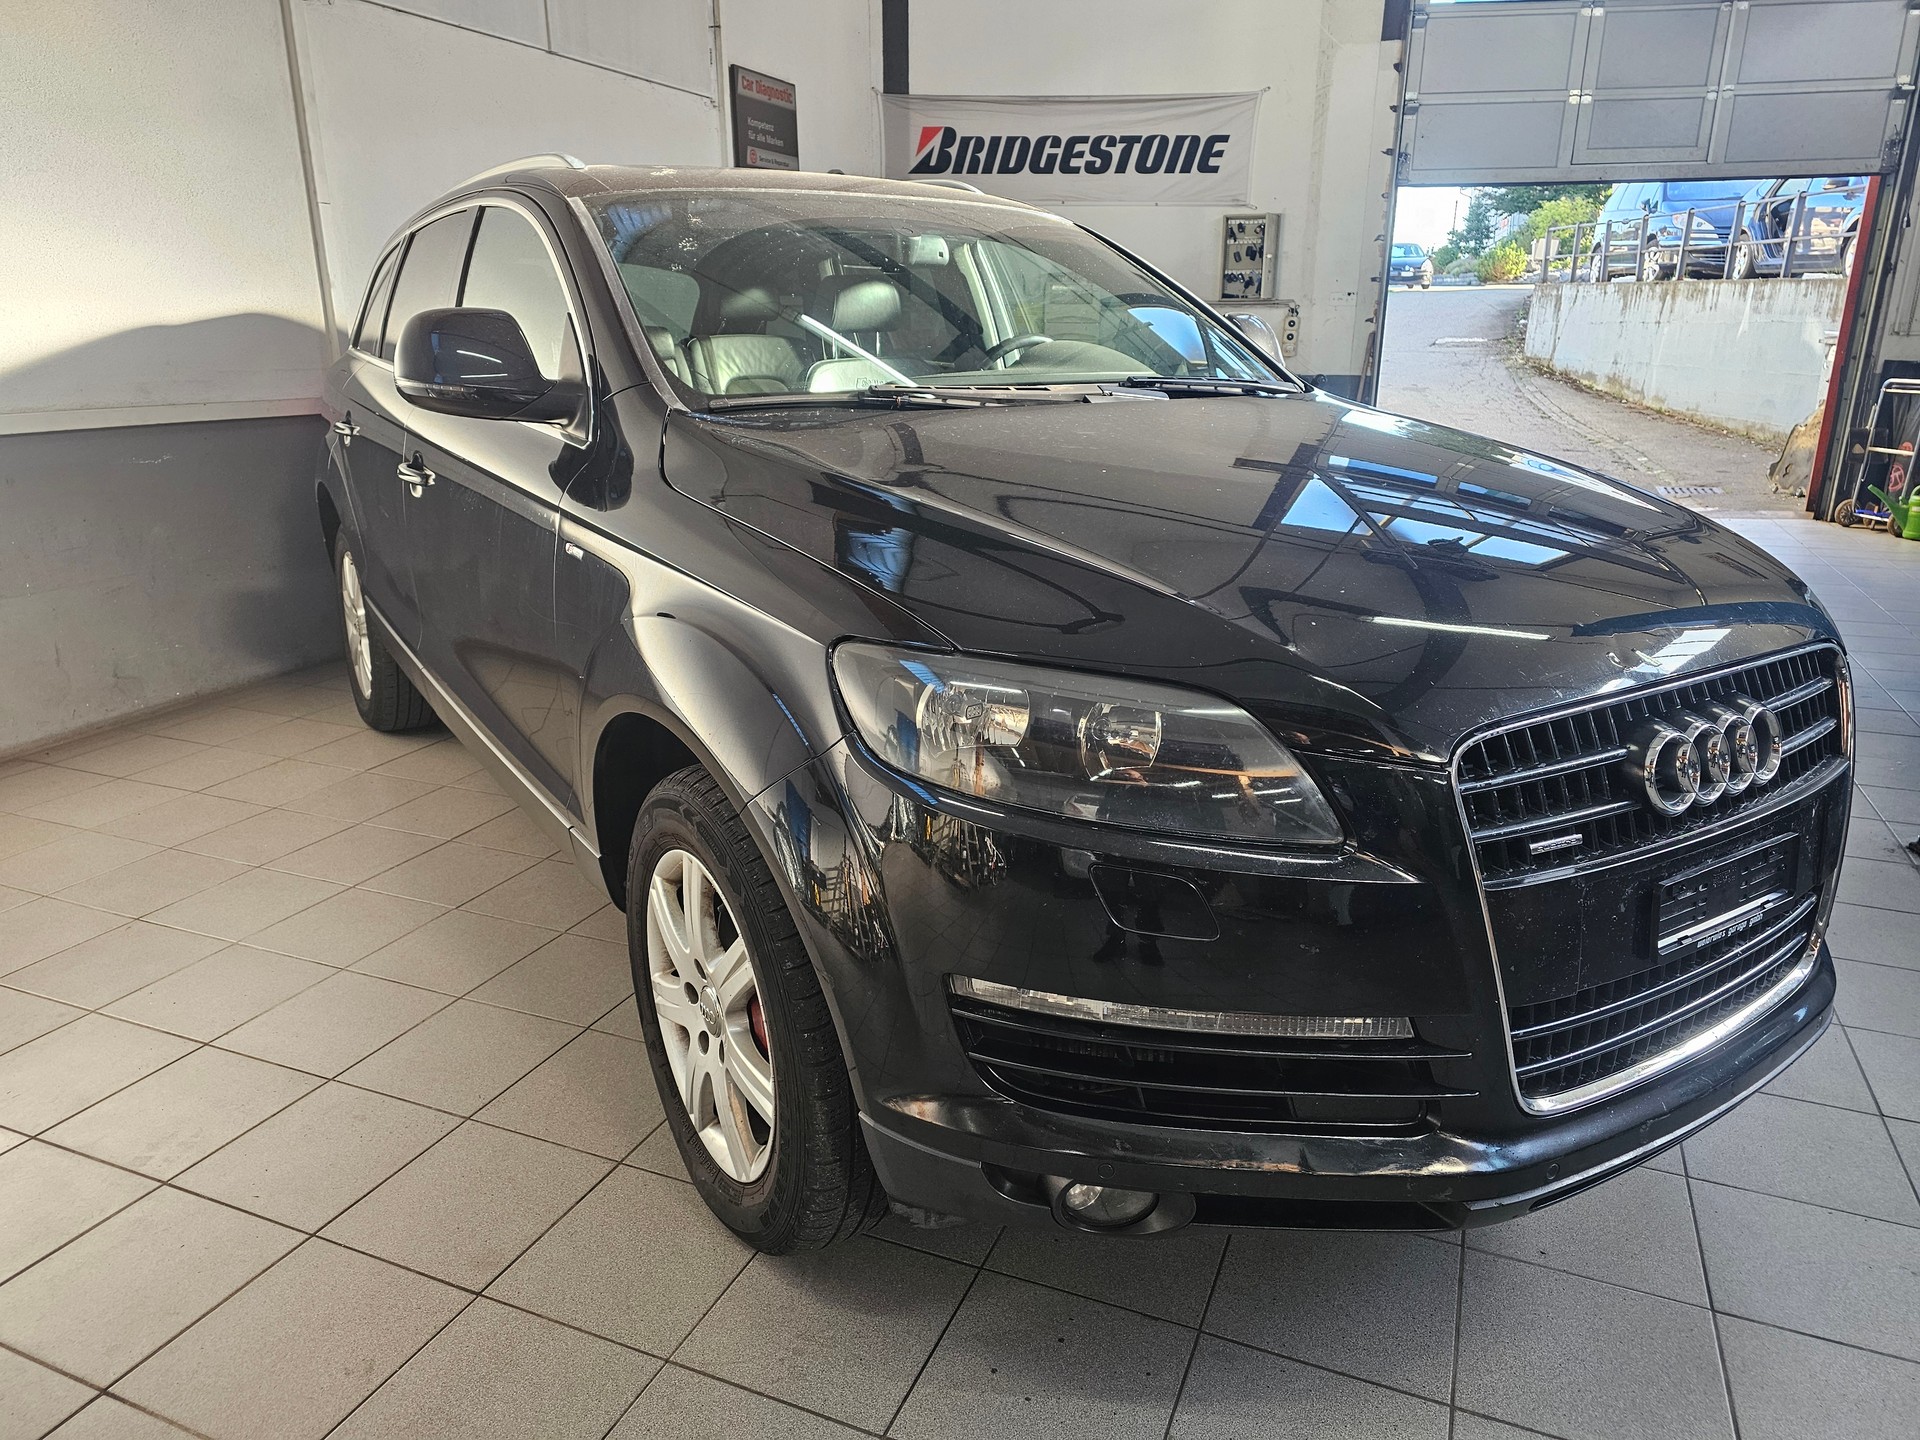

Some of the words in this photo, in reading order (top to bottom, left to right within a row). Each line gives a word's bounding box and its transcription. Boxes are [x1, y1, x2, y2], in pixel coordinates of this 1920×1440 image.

[741, 75, 754, 92] Car
[755, 79, 793, 105] Diagnostic
[747, 116, 775, 132] Kompetenz
[756, 132, 766, 143] alle
[766, 134, 784, 147] Marken
[908, 126, 1230, 174] BRIDGESTONE
